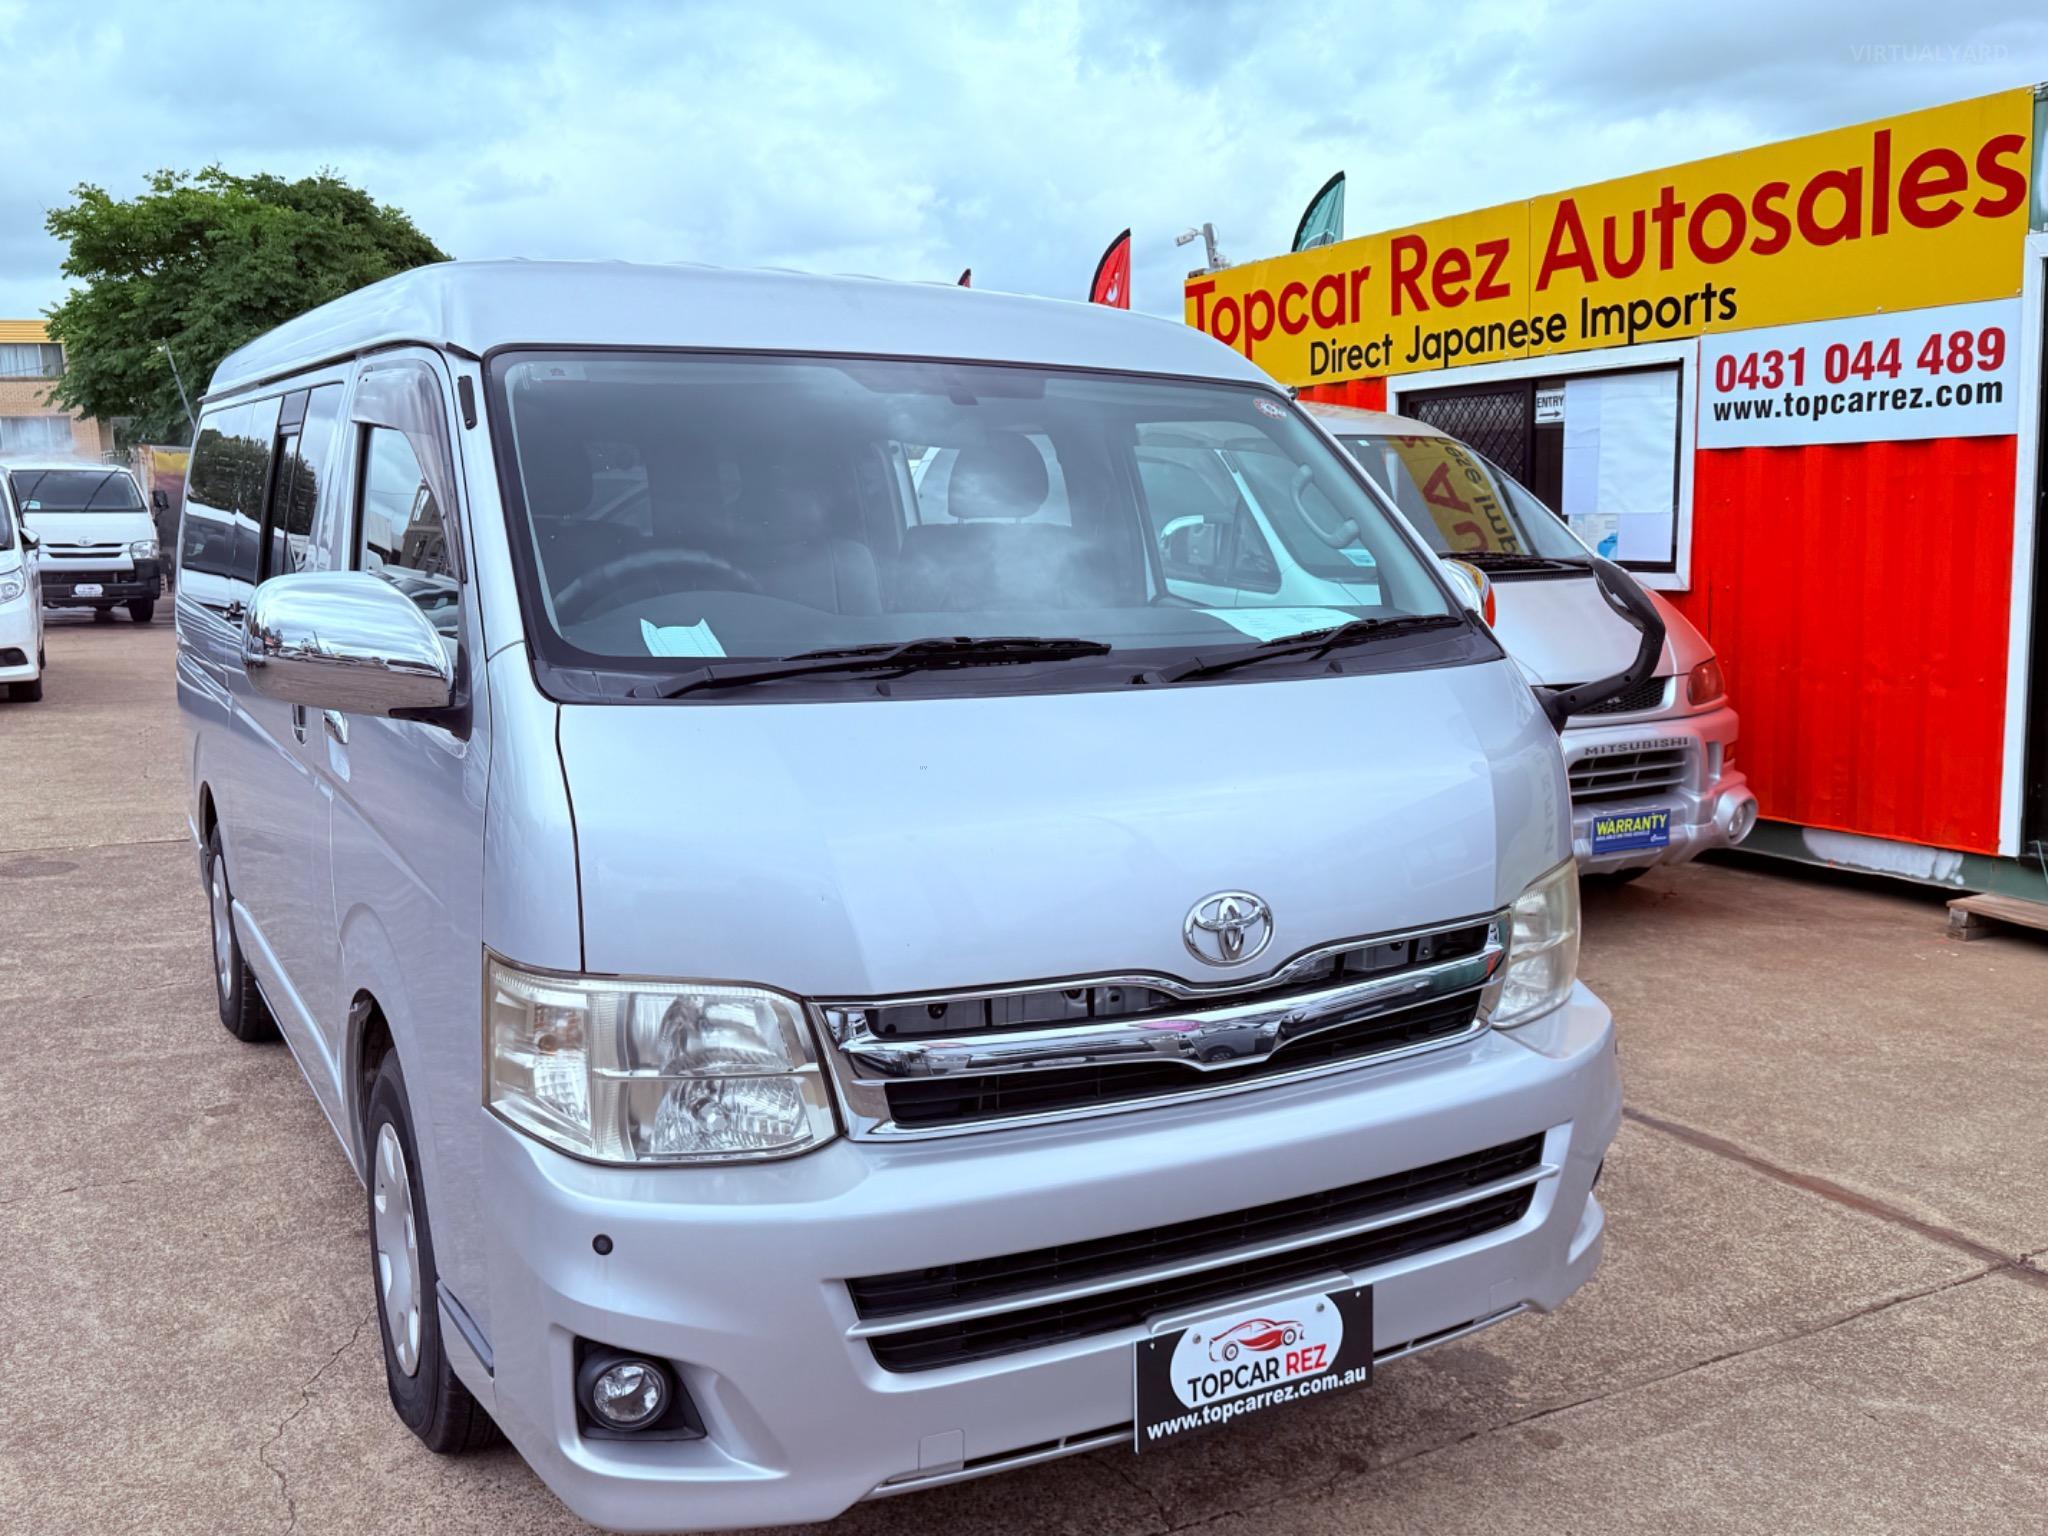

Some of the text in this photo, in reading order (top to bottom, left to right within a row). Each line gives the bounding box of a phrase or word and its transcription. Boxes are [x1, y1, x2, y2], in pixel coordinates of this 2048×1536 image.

[1185, 128, 2027, 361] Topcar Rez Autosales
[1310, 282, 1737, 376] Direct Japanese Imports
[1715, 327, 2006, 393] 0431 044 489
[1536, 394, 1565, 408] ENTRY
[1713, 381, 2003, 422] www.topcarrez.com
[1584, 736, 1689, 756] MITSUBISHI
[1597, 814, 1668, 836] WARRANTY
[1187, 1344, 1328, 1402] TOPCAR REZ
[1146, 1366, 1367, 1440] www.topcarrez.com.au
